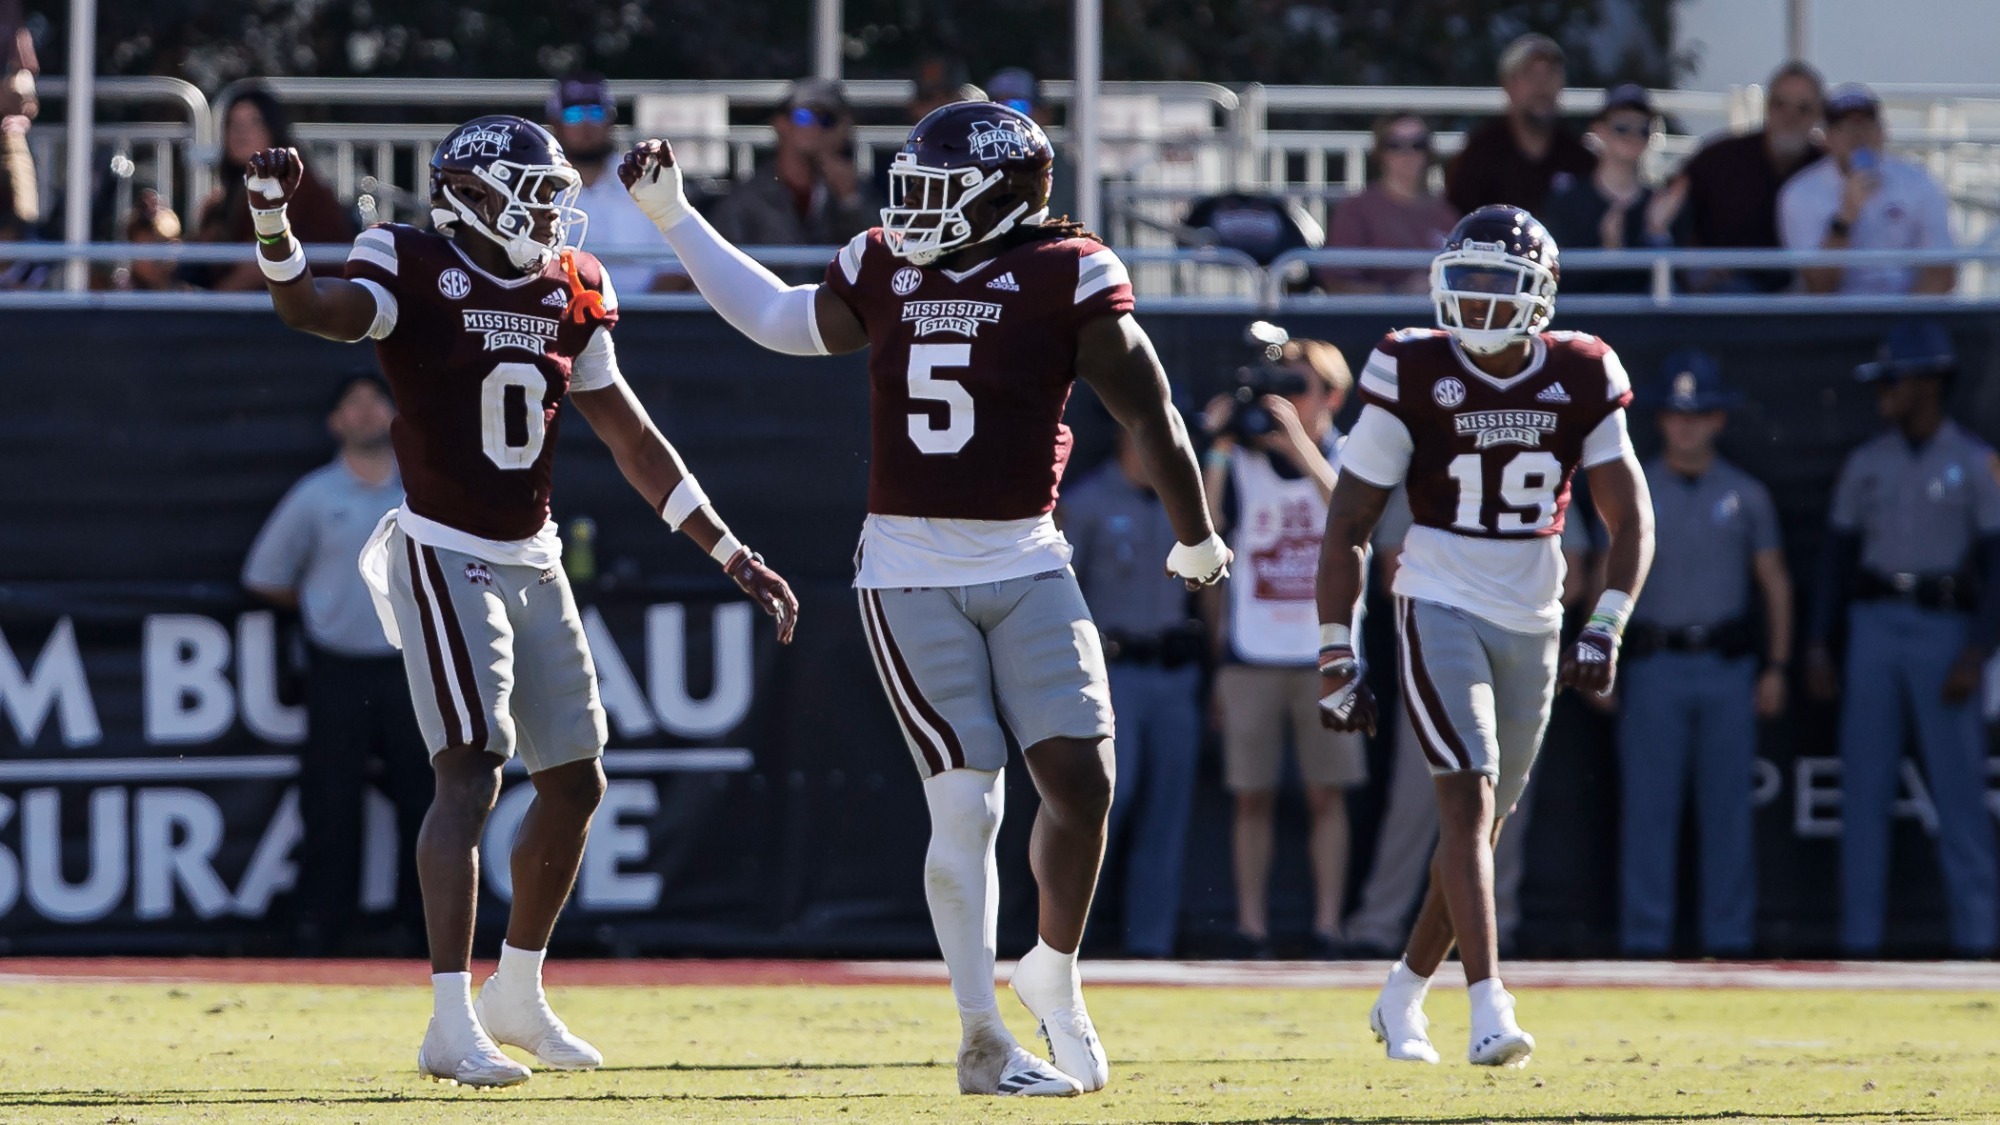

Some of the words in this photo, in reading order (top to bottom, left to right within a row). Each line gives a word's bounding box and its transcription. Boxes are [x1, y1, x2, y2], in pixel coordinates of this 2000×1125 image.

[460, 131, 500, 146] STATE
[980, 130, 1019, 144] STATE
[441, 270, 468, 297] SEC
[894, 269, 920, 293] SEC
[986, 281, 1020, 292] adidas
[902, 303, 1002, 320] MISSISSIPPI
[463, 313, 560, 337] MISSISSIPPI
[925, 319, 968, 333] STATE
[494, 333, 537, 350] STATE
[907, 343, 975, 454] 5
[1436, 379, 1464, 405] SEC
[481, 362, 547, 471] 0
[1455, 413, 1557, 430] MISSISSIPPI
[1486, 429, 1533, 443] STATE
[1447, 451, 1562, 536] 19
